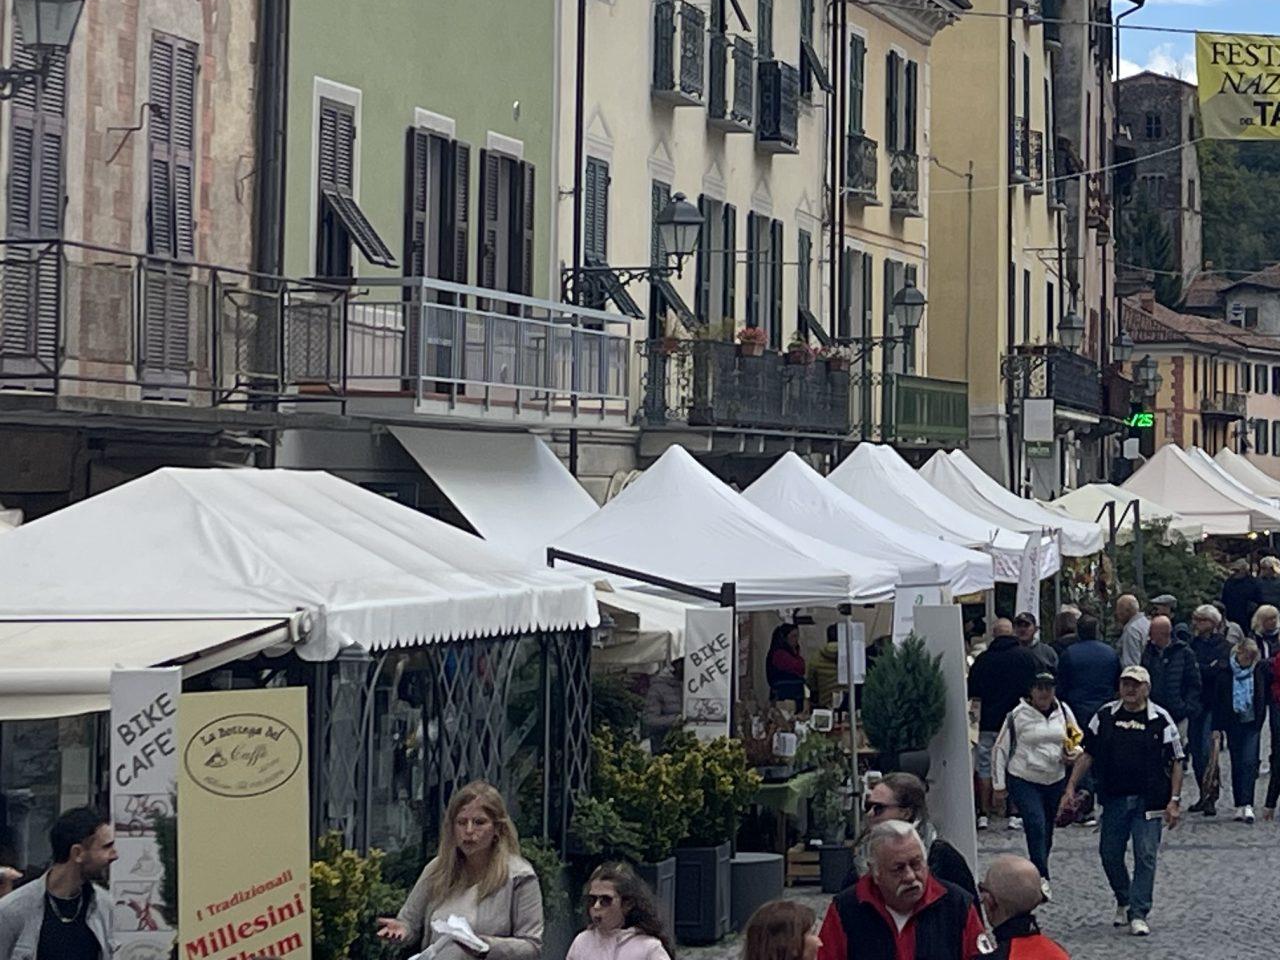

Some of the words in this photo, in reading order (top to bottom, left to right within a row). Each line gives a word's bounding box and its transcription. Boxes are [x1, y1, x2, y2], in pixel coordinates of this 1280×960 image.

[1239, 116, 1256, 126] DEL
[690, 632, 730, 668] BIKE
[116, 692, 176, 746] BIKE
[207, 869, 293, 916] Tradizionali
[185, 892, 306, 960] Millesini
